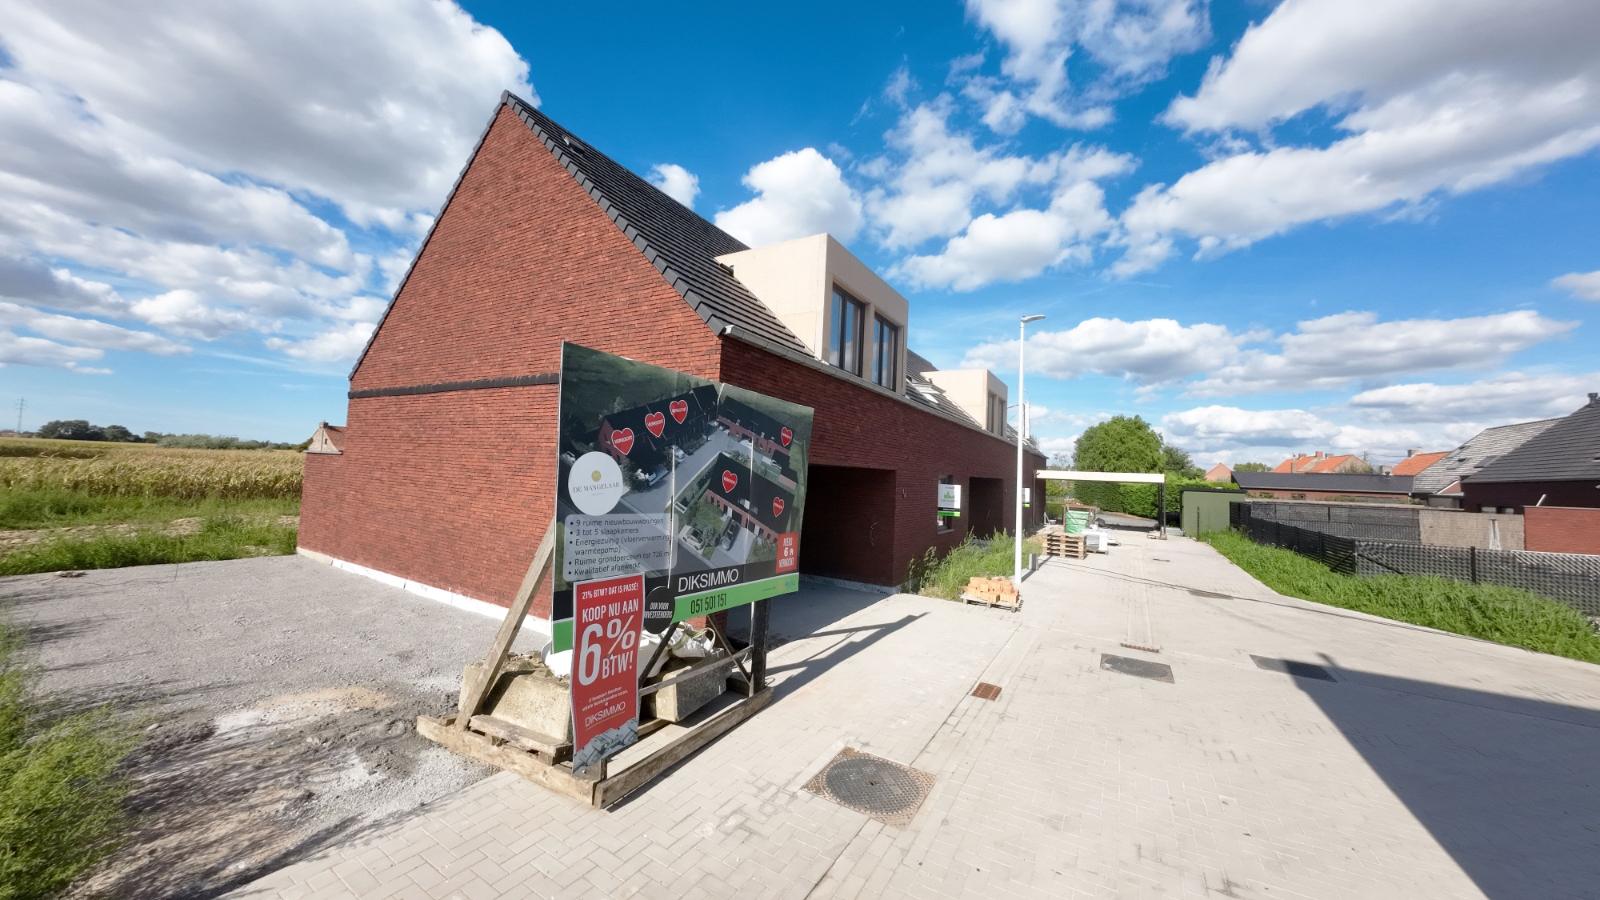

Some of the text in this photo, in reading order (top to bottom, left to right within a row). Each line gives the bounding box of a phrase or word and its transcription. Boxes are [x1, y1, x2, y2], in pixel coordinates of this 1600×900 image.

[573, 485, 583, 494] DE
[583, 519, 603, 527] ruime
[604, 517, 664, 527] nieuwbouwwoningen
[582, 528, 592, 536] tot
[600, 528, 639, 537] slaapkamers
[575, 537, 619, 547] Energiezuinig
[574, 546, 622, 556] warmtepomp)
[574, 556, 597, 566] Ruime
[597, 552, 642, 565] grondpercelen
[642, 551, 651, 559] tot
[652, 550, 663, 558] 726
[783, 547, 789, 557] 6
[574, 562, 641, 576] Kwalitatief afgewerkt
[678, 568, 739, 593] DIKSIMMO
[582, 581, 639, 600] 21% BTW? DAT IS PASSÉ!
[582, 598, 639, 623] KOOP NU AAN
[690, 592, 727, 615] 051 501 151
[578, 615, 636, 686] 6%
[602, 650, 634, 680] BTW!
[584, 701, 626, 727] DIKSIMMO
